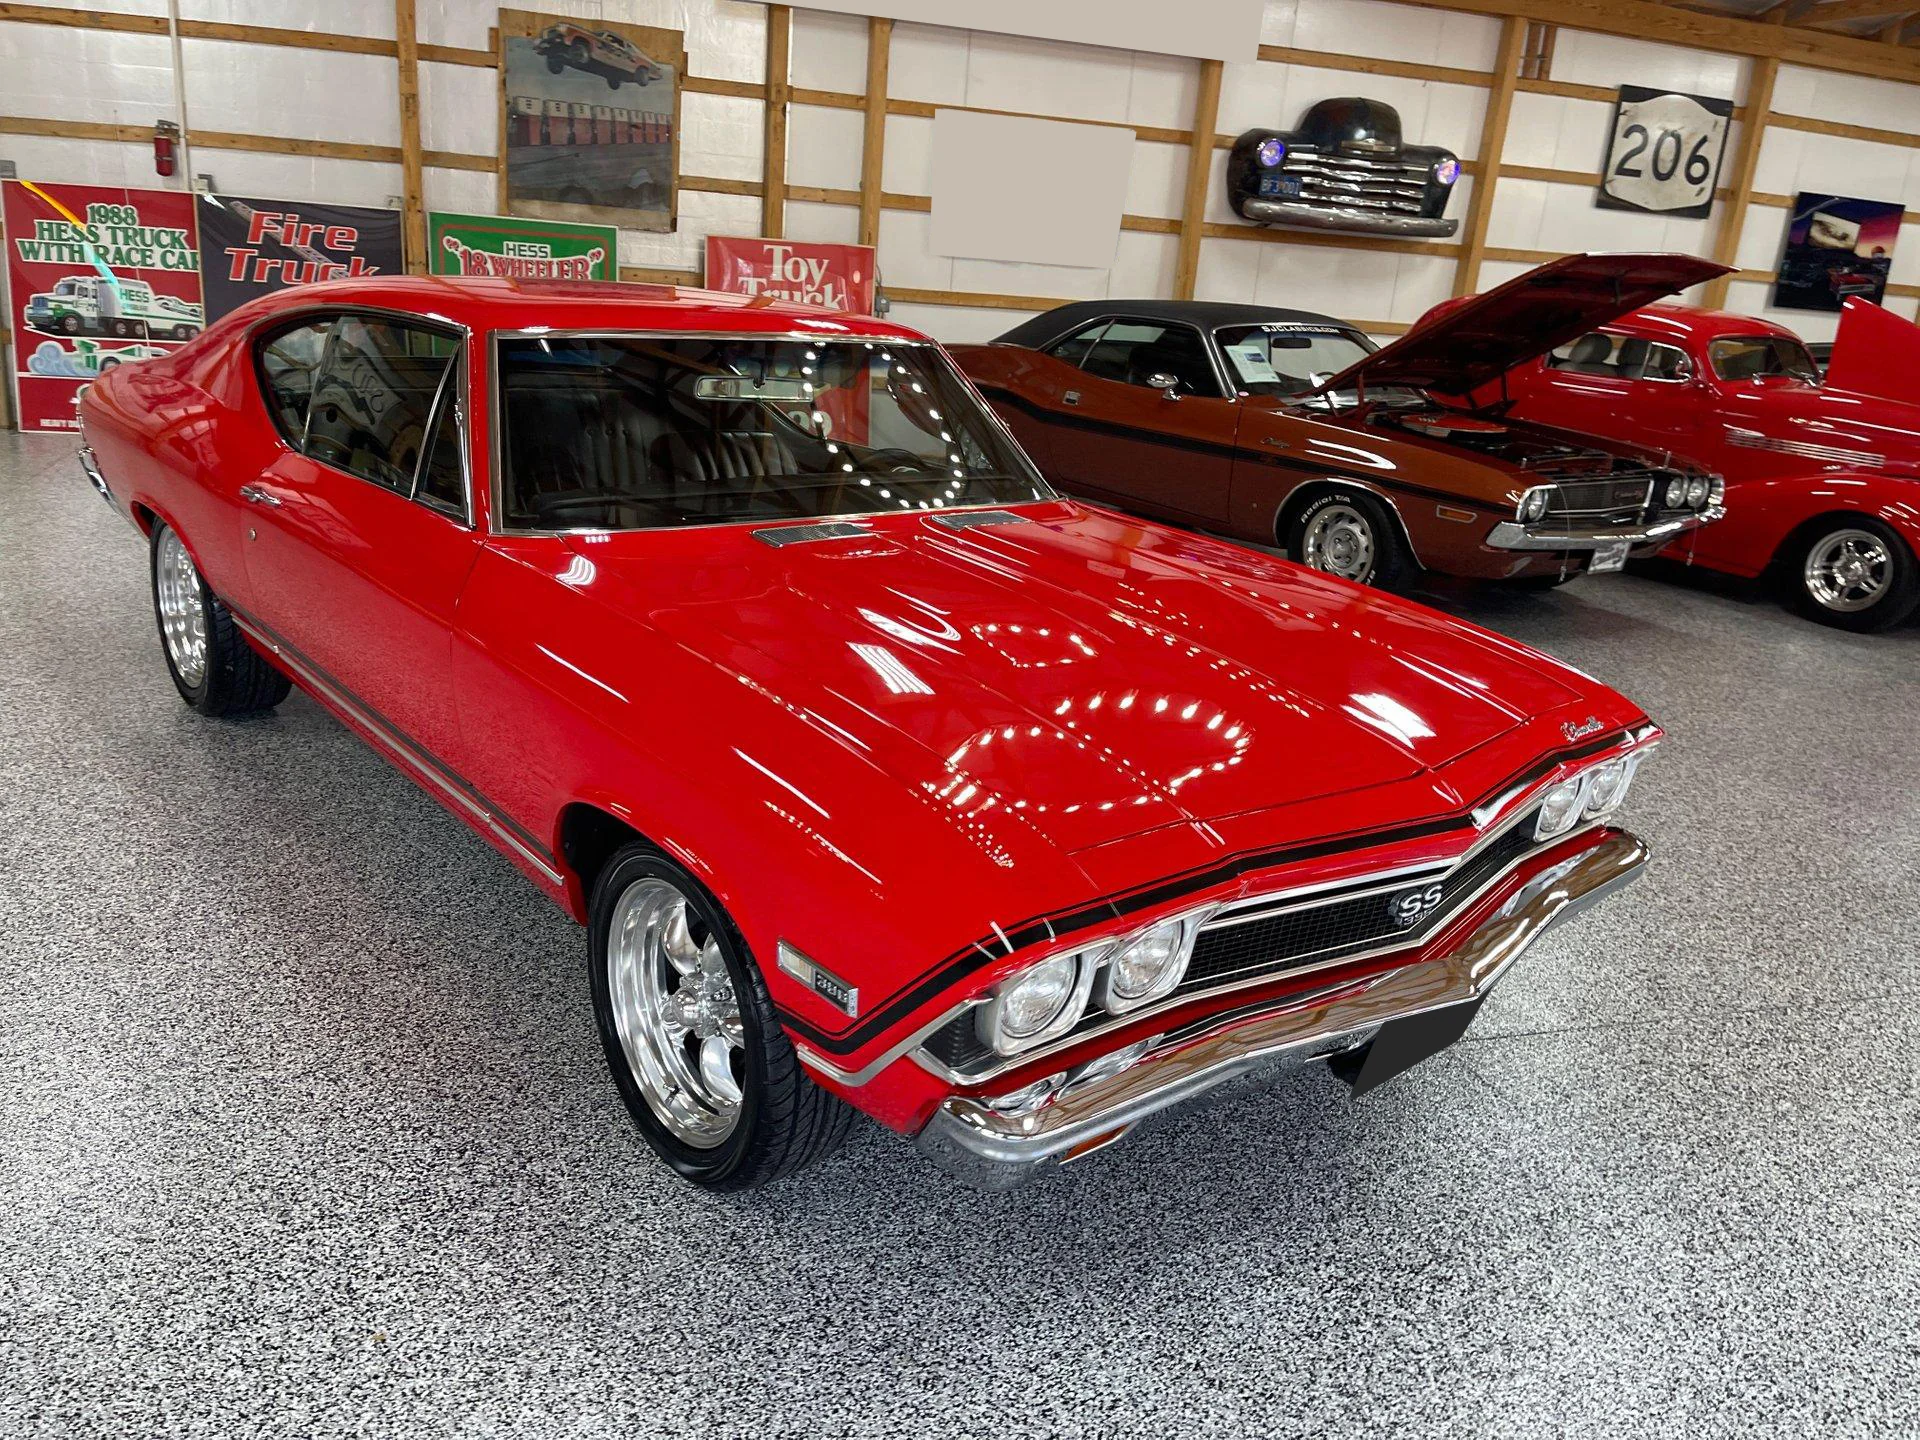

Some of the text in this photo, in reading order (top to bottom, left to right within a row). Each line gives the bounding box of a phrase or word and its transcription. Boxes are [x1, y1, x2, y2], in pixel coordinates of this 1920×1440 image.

[1614, 123, 1710, 186] 206
[88, 205, 138, 226] 1988
[36, 221, 187, 250] HESS TRUCK
[247, 211, 358, 251] Fire
[18, 240, 86, 263] WITH
[94, 244, 155, 267] RACE
[505, 242, 549, 259] HESS
[763, 244, 830, 292] Toy
[120, 287, 150, 303] HESS
[1398, 884, 1443, 918] SS
